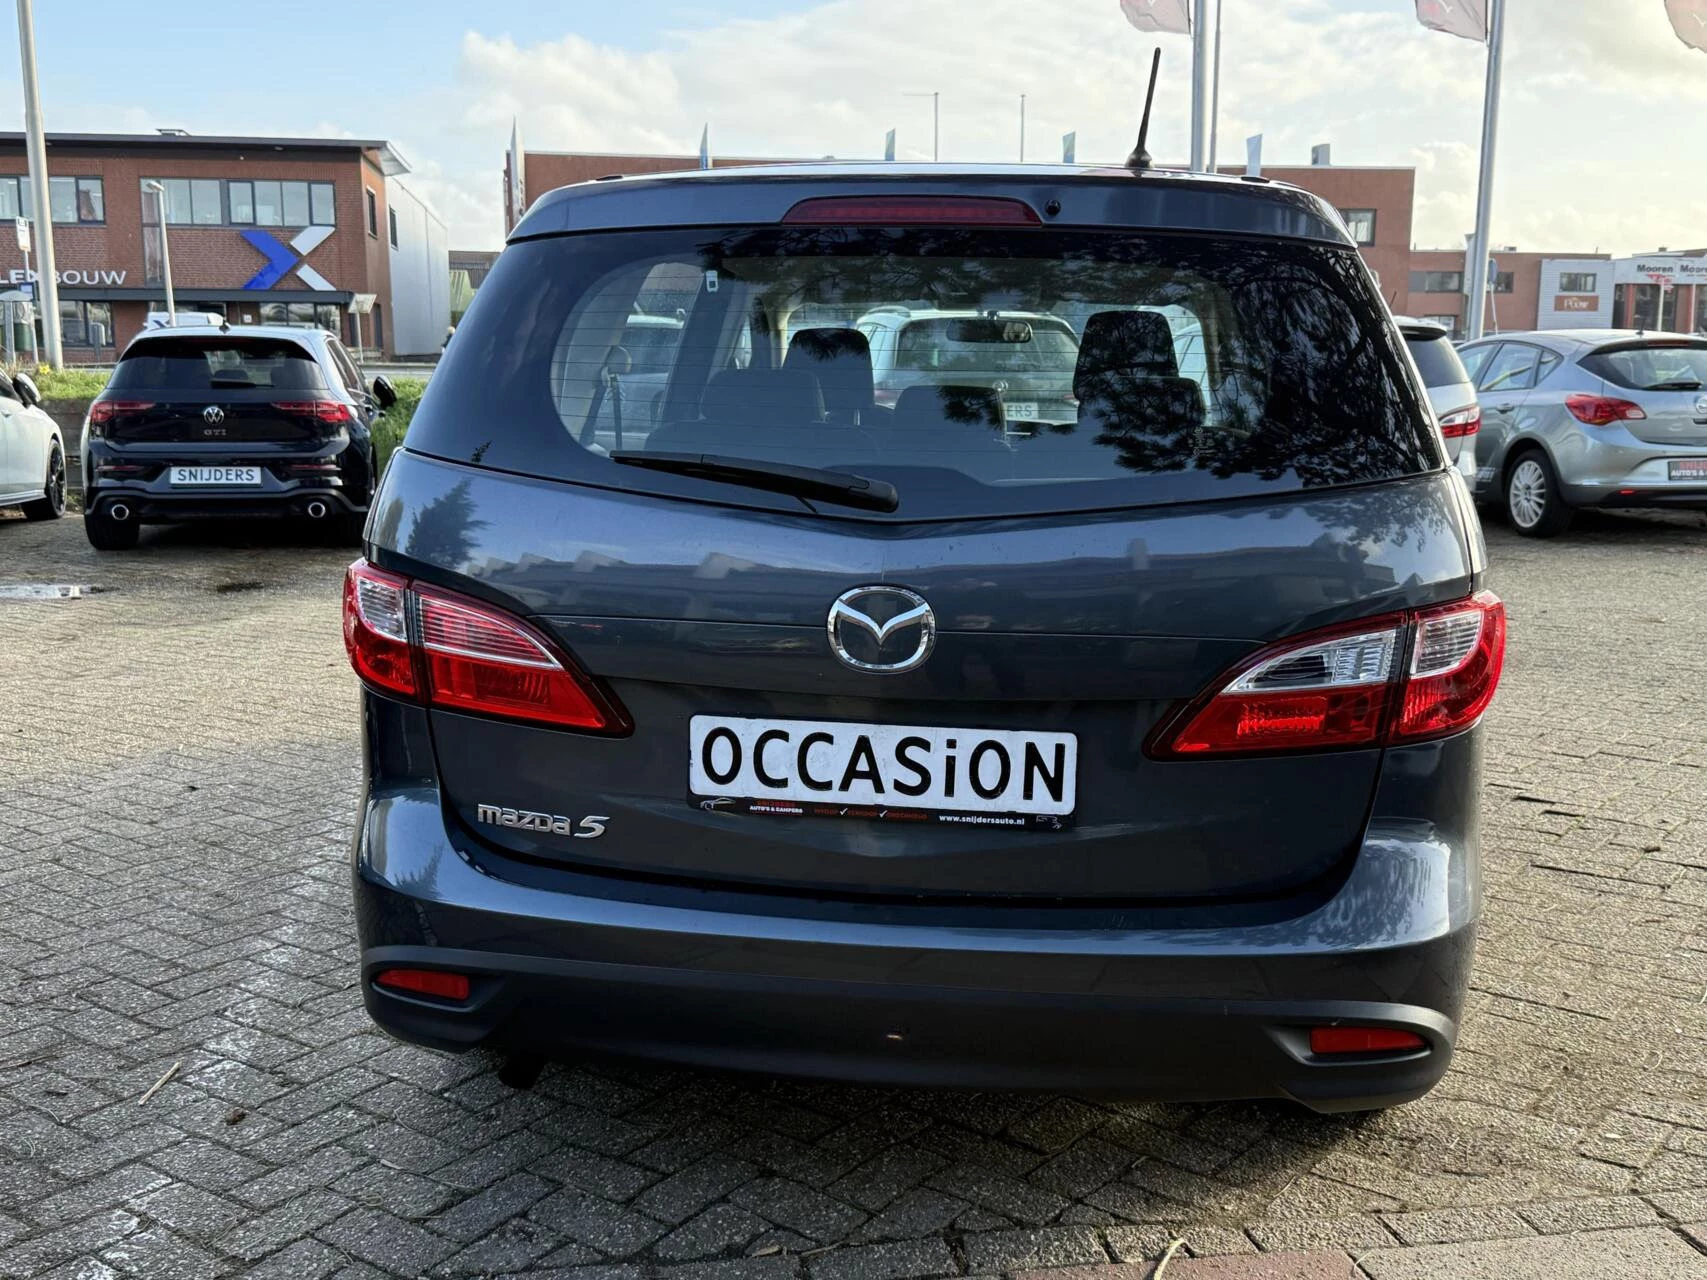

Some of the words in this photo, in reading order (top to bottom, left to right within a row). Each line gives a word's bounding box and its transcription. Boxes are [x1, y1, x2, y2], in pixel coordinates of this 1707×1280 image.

[1637, 264, 1673, 273] Mooren
[203, 428, 227, 436] GTI
[177, 468, 255, 482] SNIJDERS
[939, 814, 1025, 826] www.snijdersauto.nl
[574, 815, 610, 838] 5
